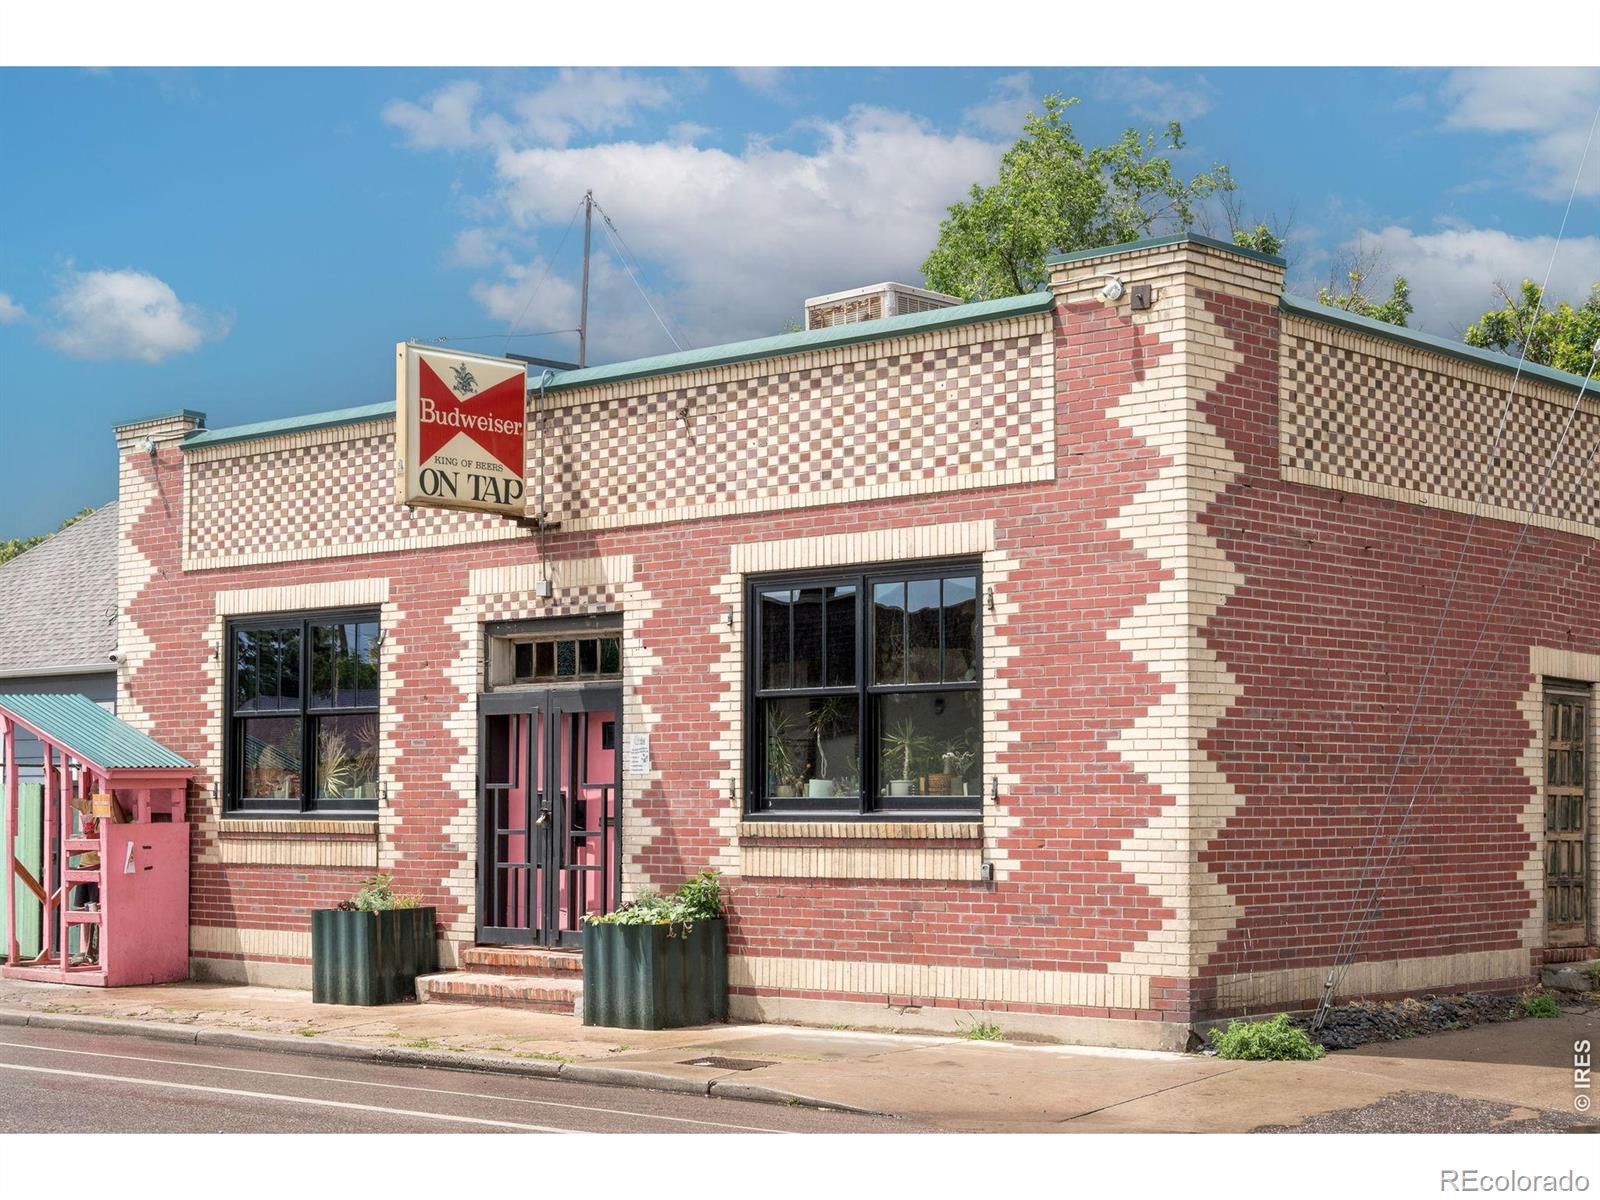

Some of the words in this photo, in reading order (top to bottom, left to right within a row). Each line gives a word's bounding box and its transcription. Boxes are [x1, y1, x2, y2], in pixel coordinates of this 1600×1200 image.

[420, 398, 522, 435] Budweiser
[434, 455, 458, 467] KING
[461, 460, 473, 468] OF
[475, 461, 504, 472] BEERS
[419, 468, 460, 497] ON
[467, 474, 524, 505] TAP
